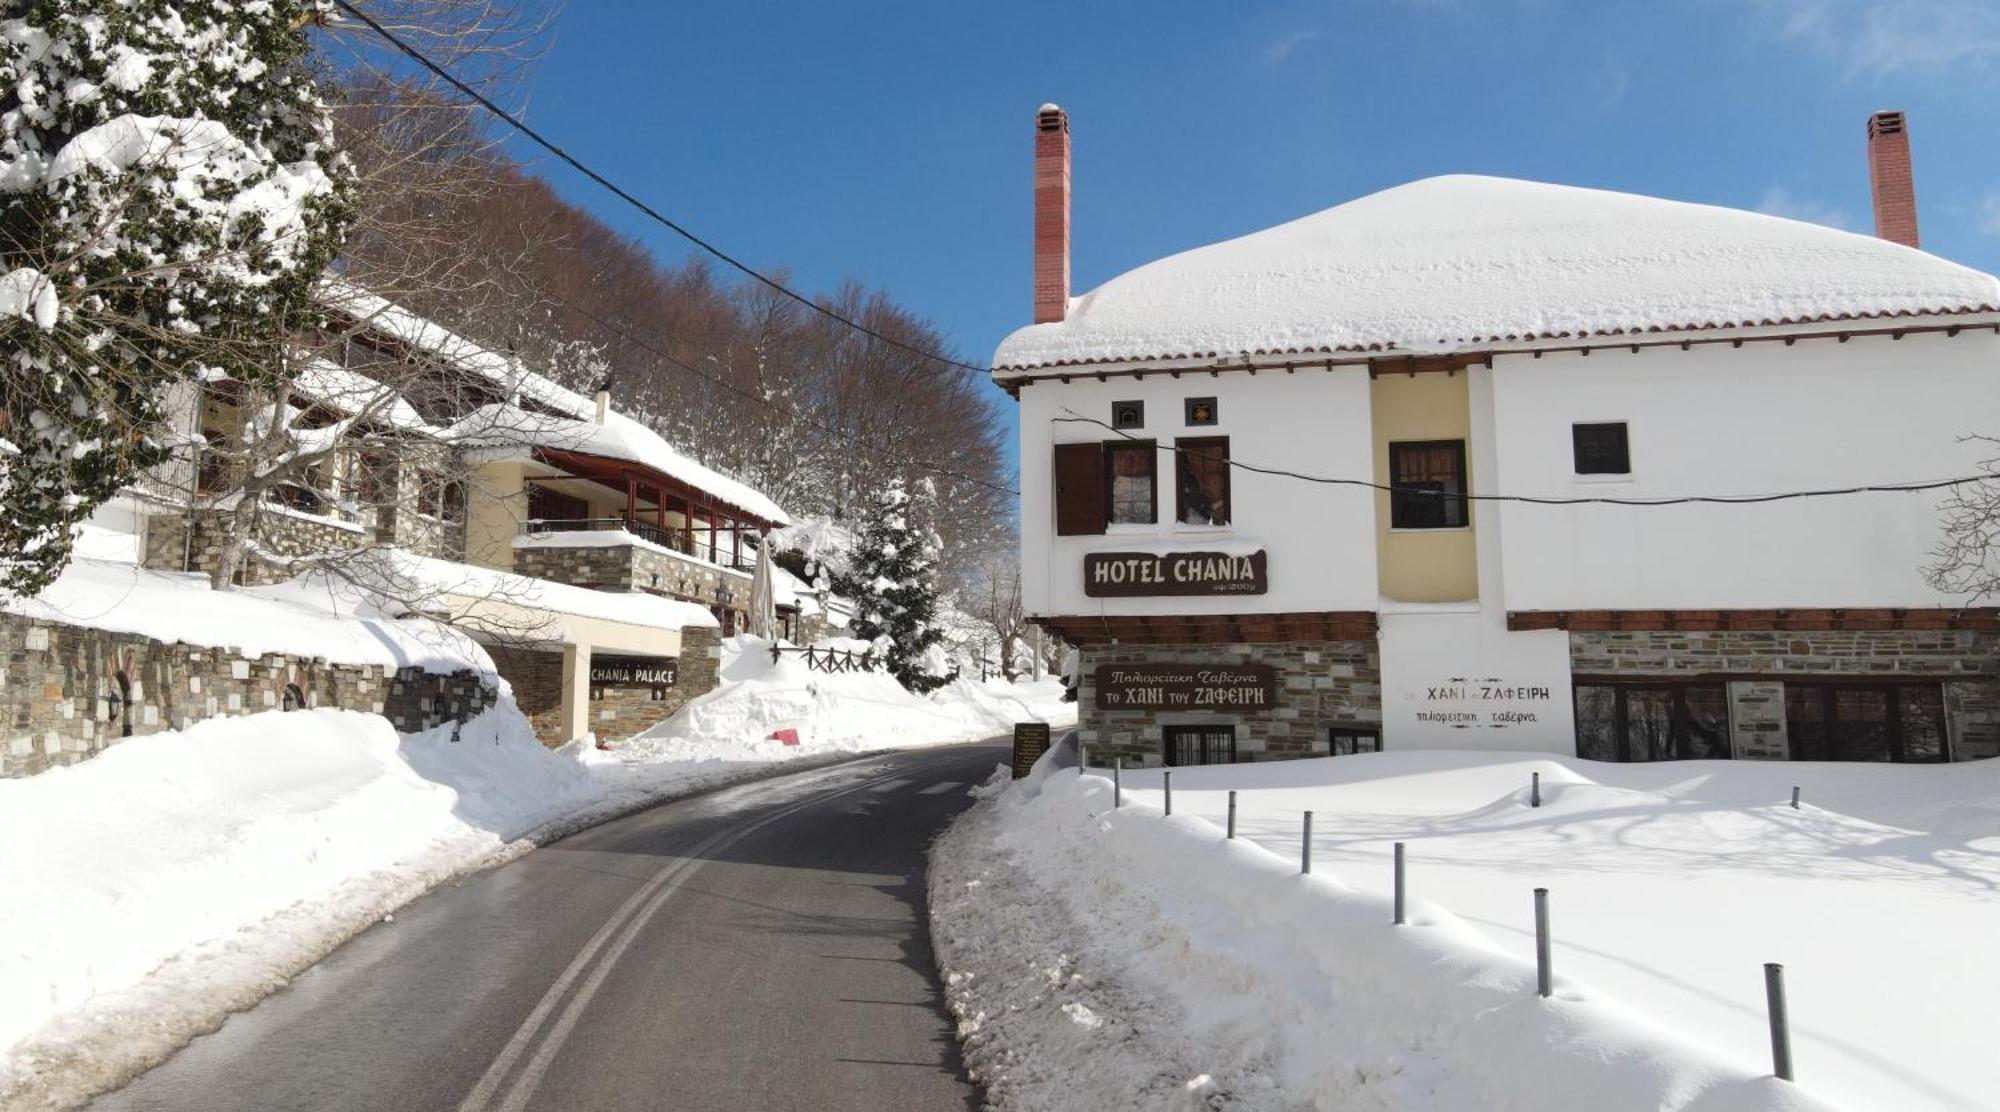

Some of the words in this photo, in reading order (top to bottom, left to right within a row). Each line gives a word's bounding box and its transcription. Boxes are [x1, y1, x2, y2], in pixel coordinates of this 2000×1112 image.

[1095, 560, 1165, 583] HOTEL
[1174, 558, 1254, 582] CHANIA
[591, 668, 630, 681] CHANIA
[635, 670, 674, 683] PALACE
[1197, 671, 1257, 685] Ταβέρνα
[1125, 688, 1163, 704] ΧΑΝΙ
[1194, 687, 1264, 705] ΖΑΦΕΙΡΗ
[1427, 688, 1465, 700] ΧΑΝΙ
[1481, 688, 1549, 700] ΖΑΦΕΙΡΗ
